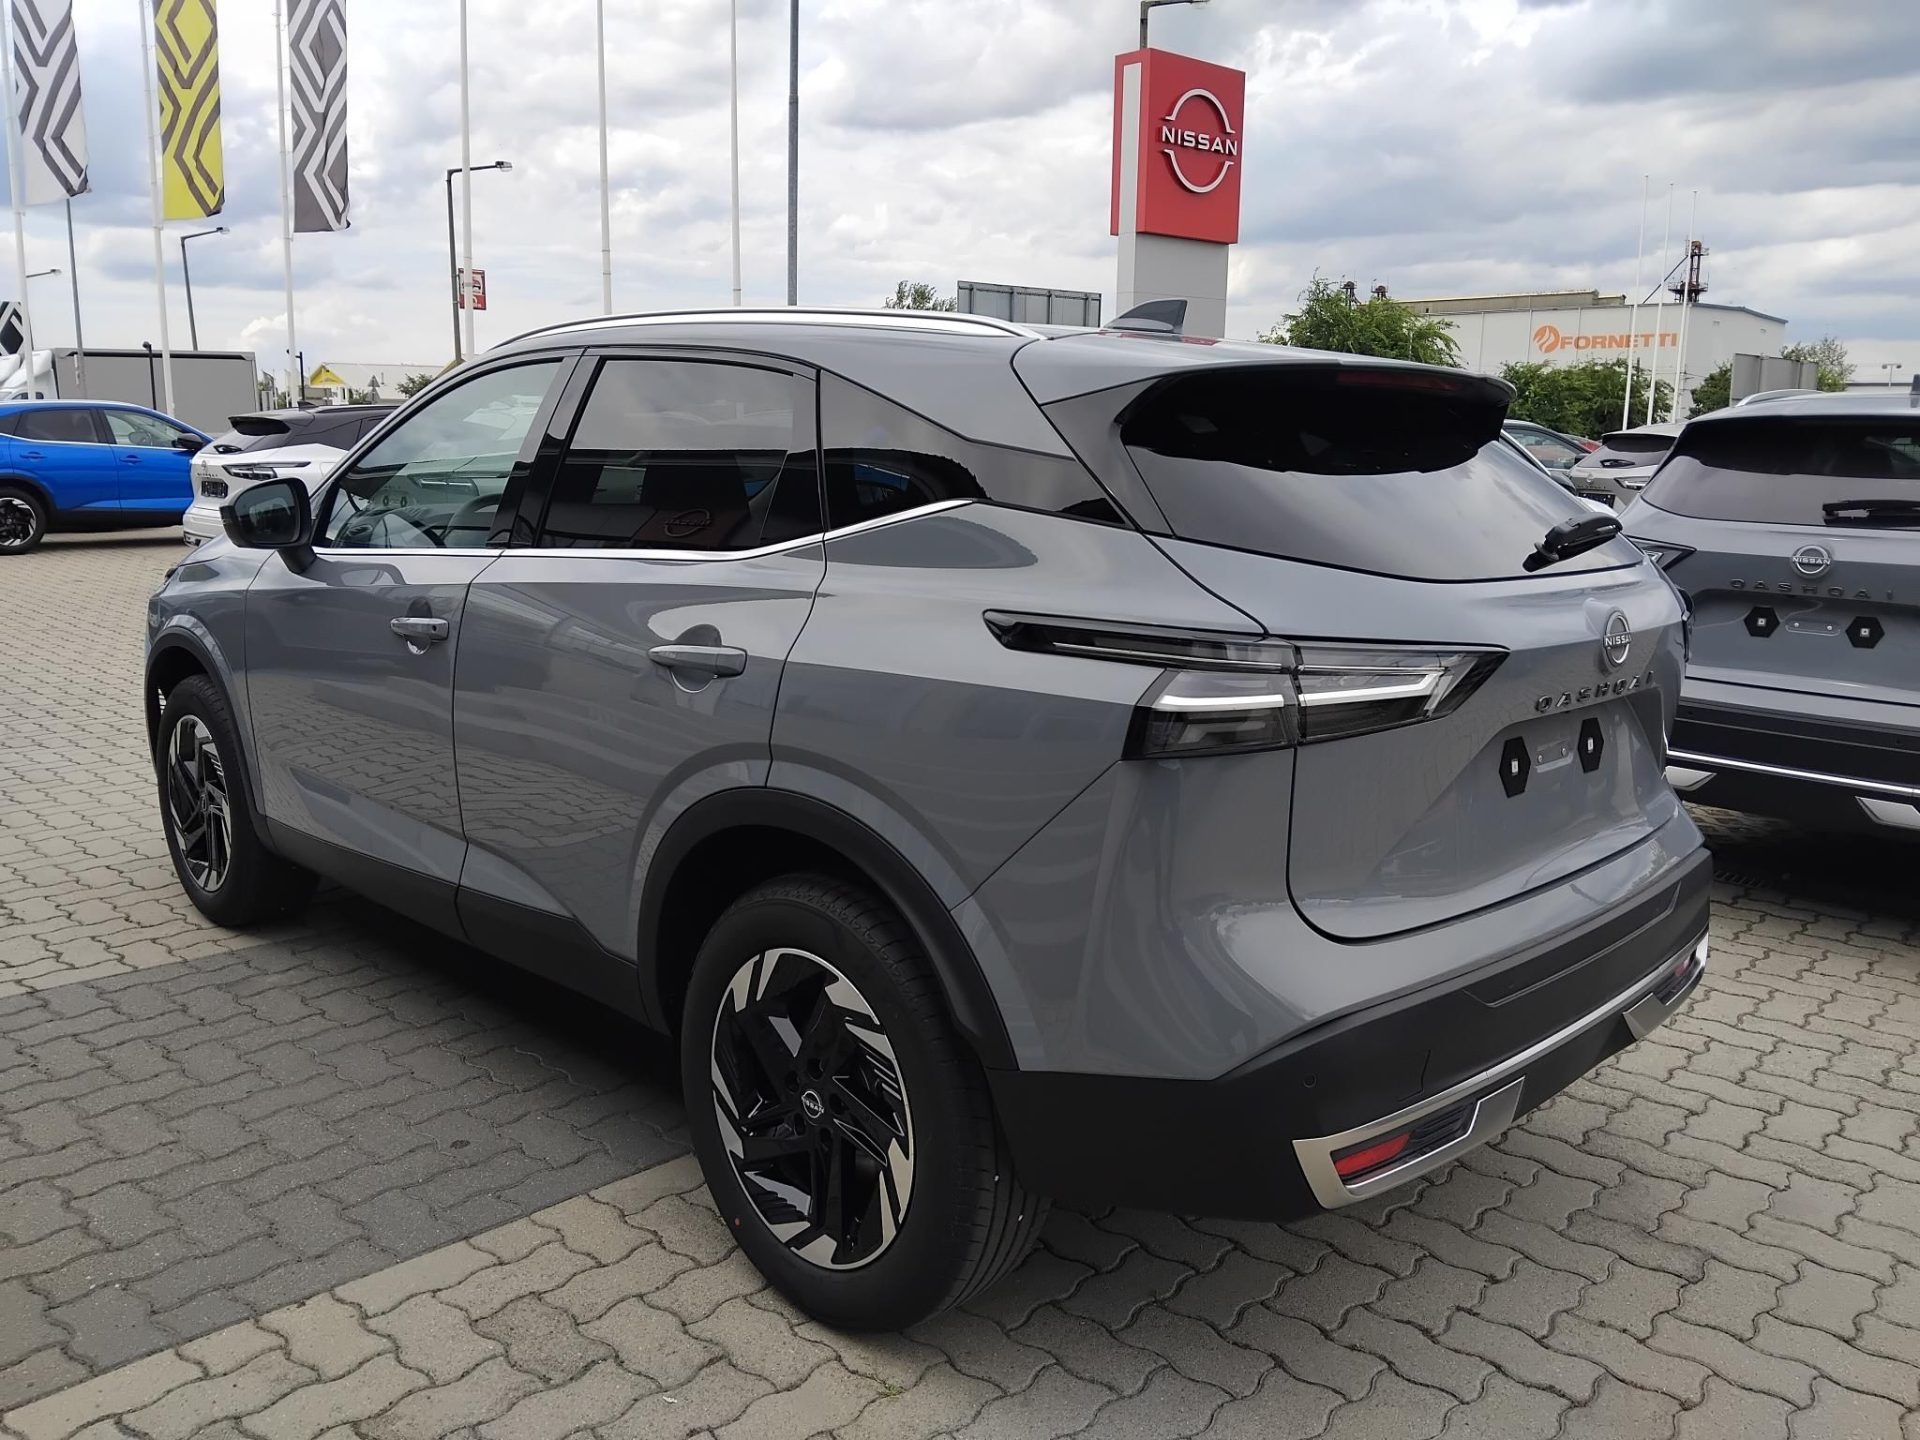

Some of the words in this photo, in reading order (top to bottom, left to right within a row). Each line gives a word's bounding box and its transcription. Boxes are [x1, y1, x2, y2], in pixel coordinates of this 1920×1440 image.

[1161, 125, 1238, 156] NISSAN
[1560, 332, 1677, 350] FORNETTI
[1792, 556, 1831, 565] NISSAN
[1729, 578, 1894, 600] QASHQAI
[1534, 670, 1655, 713] QASHQAI
